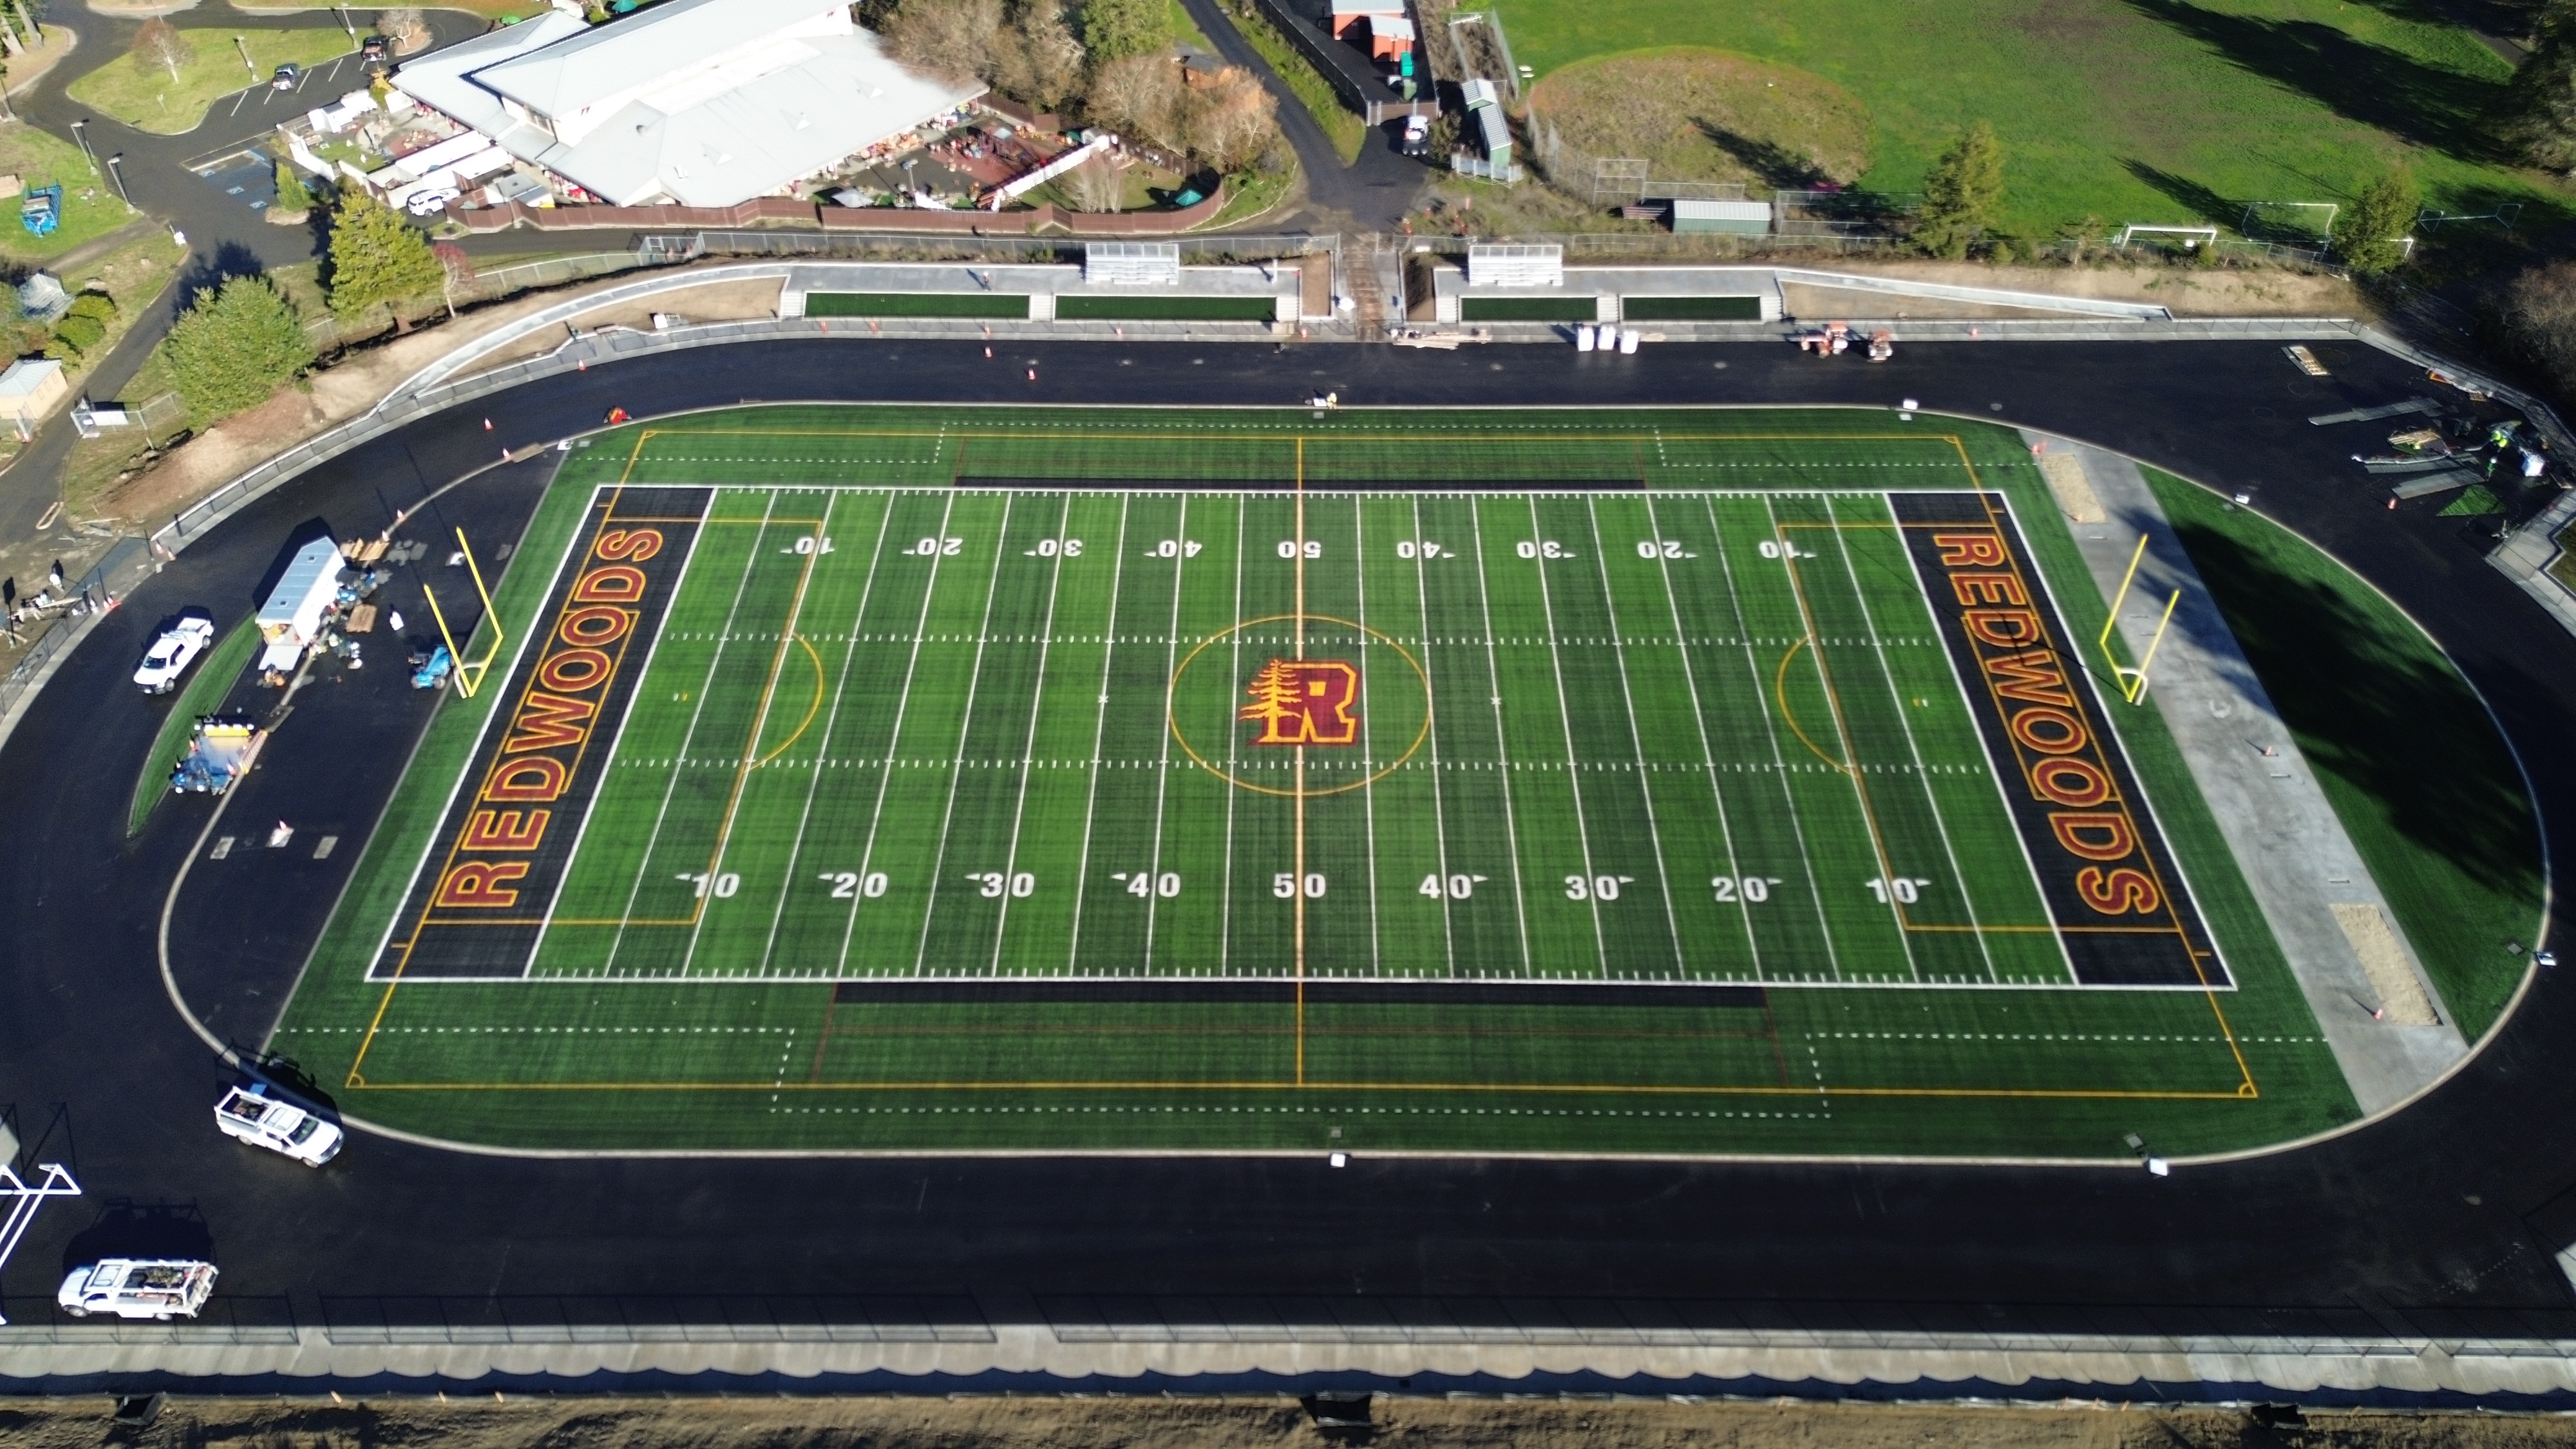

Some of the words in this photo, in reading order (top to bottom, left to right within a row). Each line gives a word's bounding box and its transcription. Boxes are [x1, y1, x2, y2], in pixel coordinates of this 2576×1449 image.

[917, 537, 963, 555] 20
[1038, 539, 1083, 557] 30
[1159, 540, 1202, 558] 40
[1278, 542, 1321, 559] 50
[1397, 542, 1441, 558] 40
[1517, 542, 1561, 559] 30
[1638, 542, 1683, 559] 20
[1253, 658, 1361, 746] R
[435, 528, 663, 907] REDWOODS
[1934, 533, 2160, 916] REDWOODS
[691, 873, 741, 898] 10
[831, 873, 888, 898] 20
[980, 873, 1035, 898] 30
[1127, 873, 1180, 898] 40
[1273, 873, 1326, 898] 50
[1419, 874, 1472, 899] 40
[1565, 875, 1619, 900] 30
[1712, 876, 1768, 902] 20
[1866, 877, 1918, 904] 10
